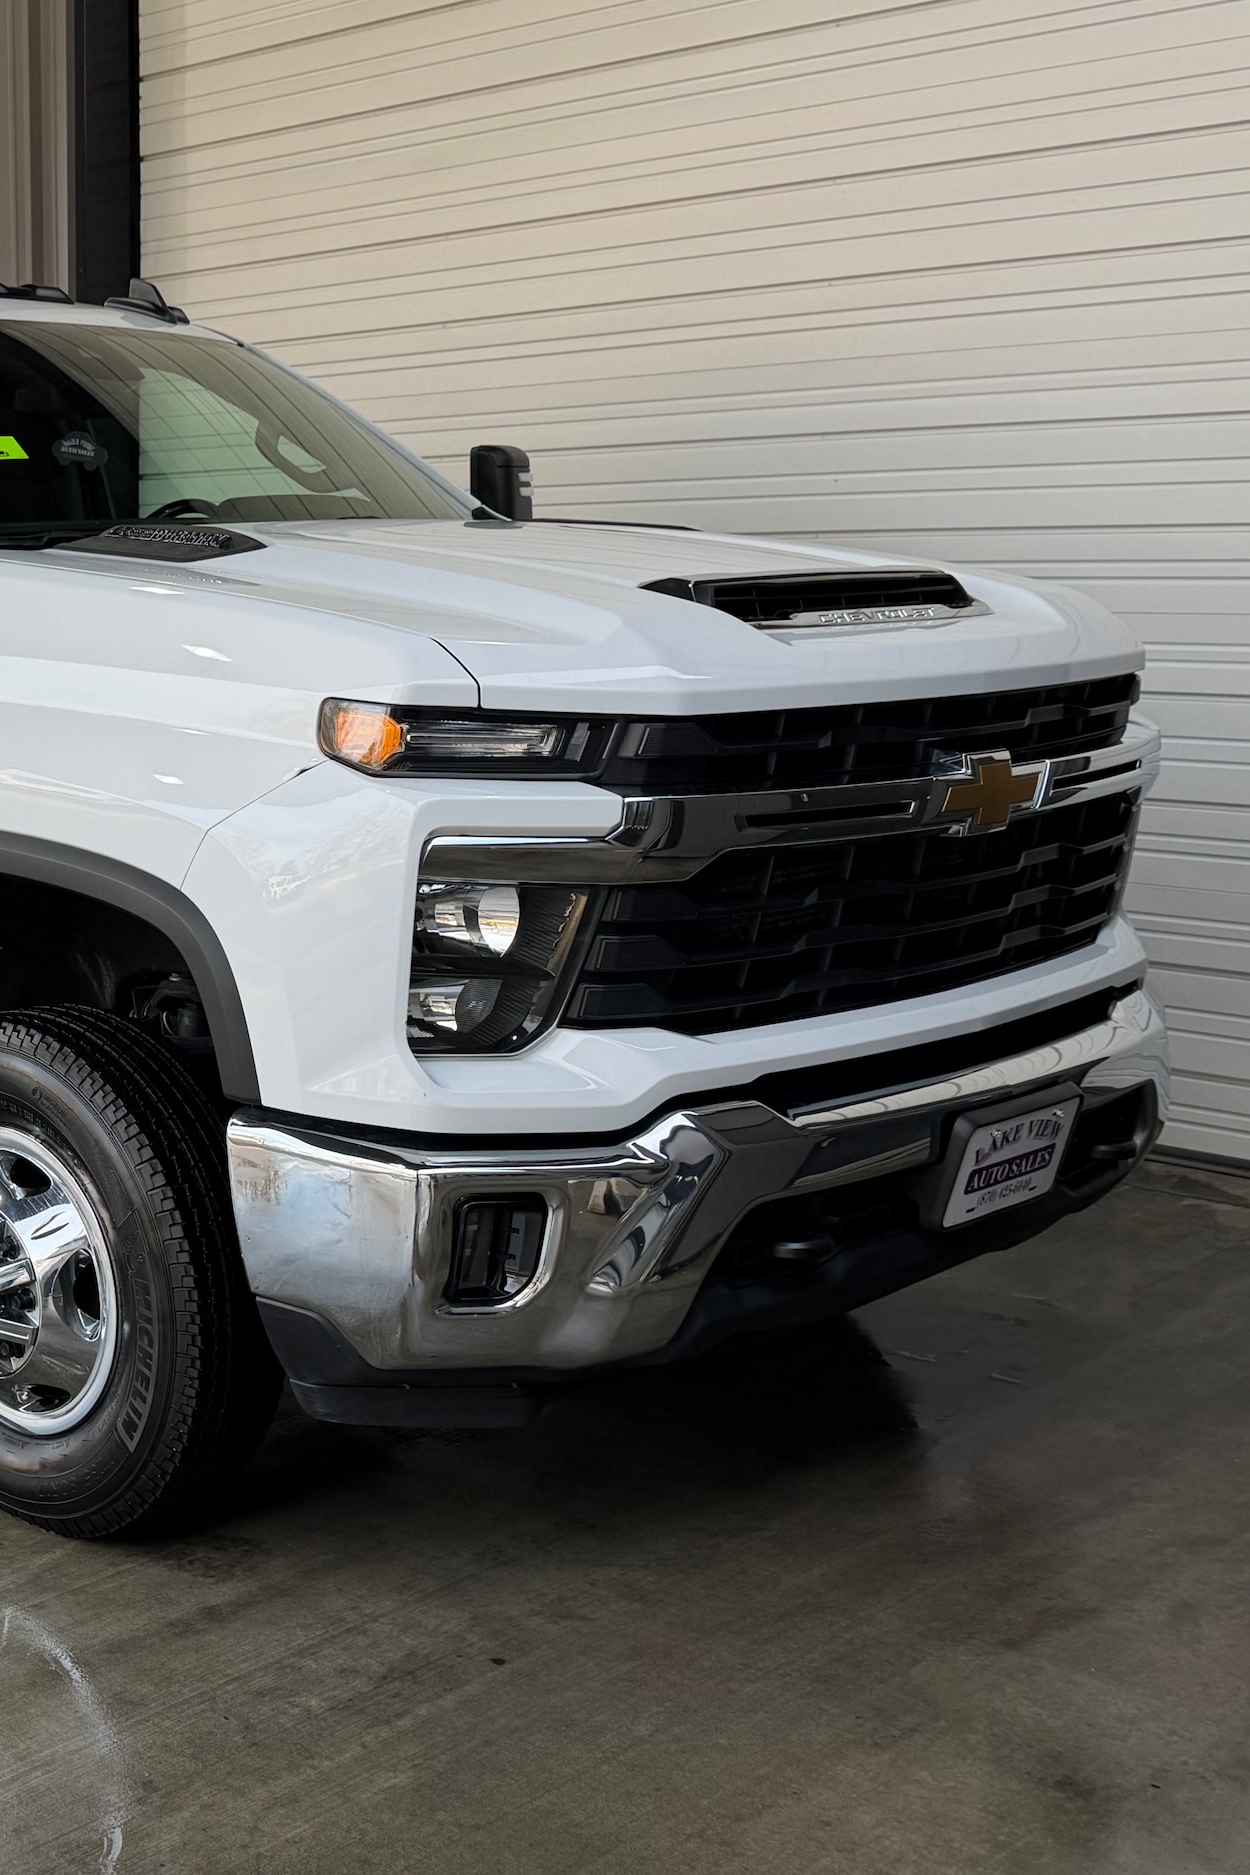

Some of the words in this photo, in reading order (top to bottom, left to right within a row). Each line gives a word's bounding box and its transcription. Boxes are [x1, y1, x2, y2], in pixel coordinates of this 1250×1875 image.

[818, 607, 934, 623] CHEVROLET
[975, 1122, 1024, 1166] LAKE
[1027, 1118, 1065, 1141] VIEW
[968, 1166, 1008, 1191] AUTO
[1008, 1149, 1052, 1177] SALES
[120, 1278, 156, 1443] MICHELIN
